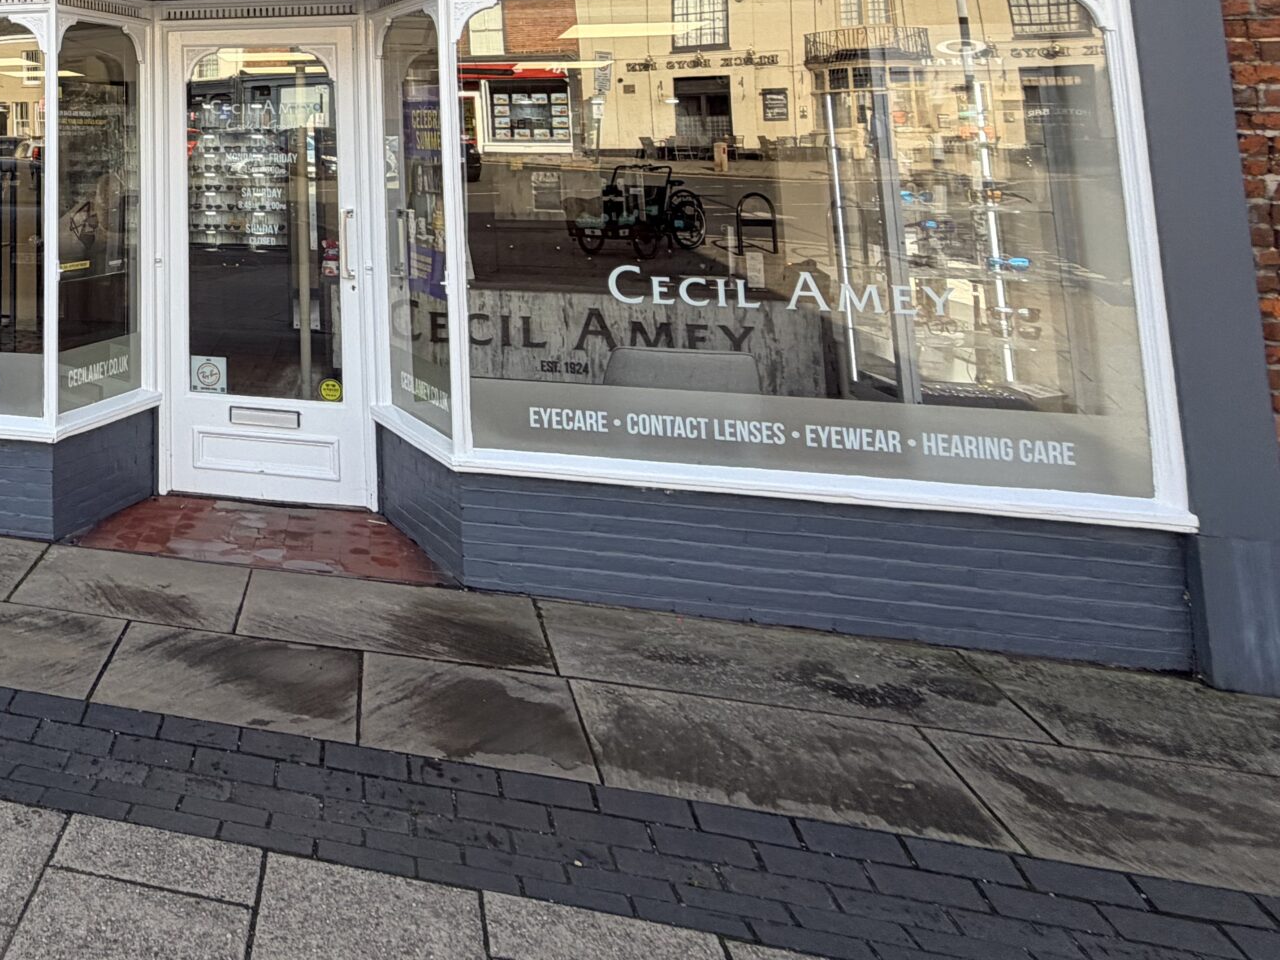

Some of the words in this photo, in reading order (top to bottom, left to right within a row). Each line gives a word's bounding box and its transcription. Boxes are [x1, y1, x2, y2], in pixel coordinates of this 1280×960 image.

[416, 130, 441, 150] SUMME
[607, 265, 761, 309] CECIL
[786, 271, 955, 317] AMEY
[68, 354, 129, 388] CECILAMEY.CO.UK
[540, 359, 562, 375] EST.
[564, 360, 590, 376] 1924
[529, 407, 609, 433] EYECARE
[627, 412, 709, 440] CONTACT
[713, 418, 786, 445] LENSES
[806, 424, 902, 453] EYEWEAR
[922, 431, 1014, 462] HEARING
[1019, 438, 1077, 466] CARE
